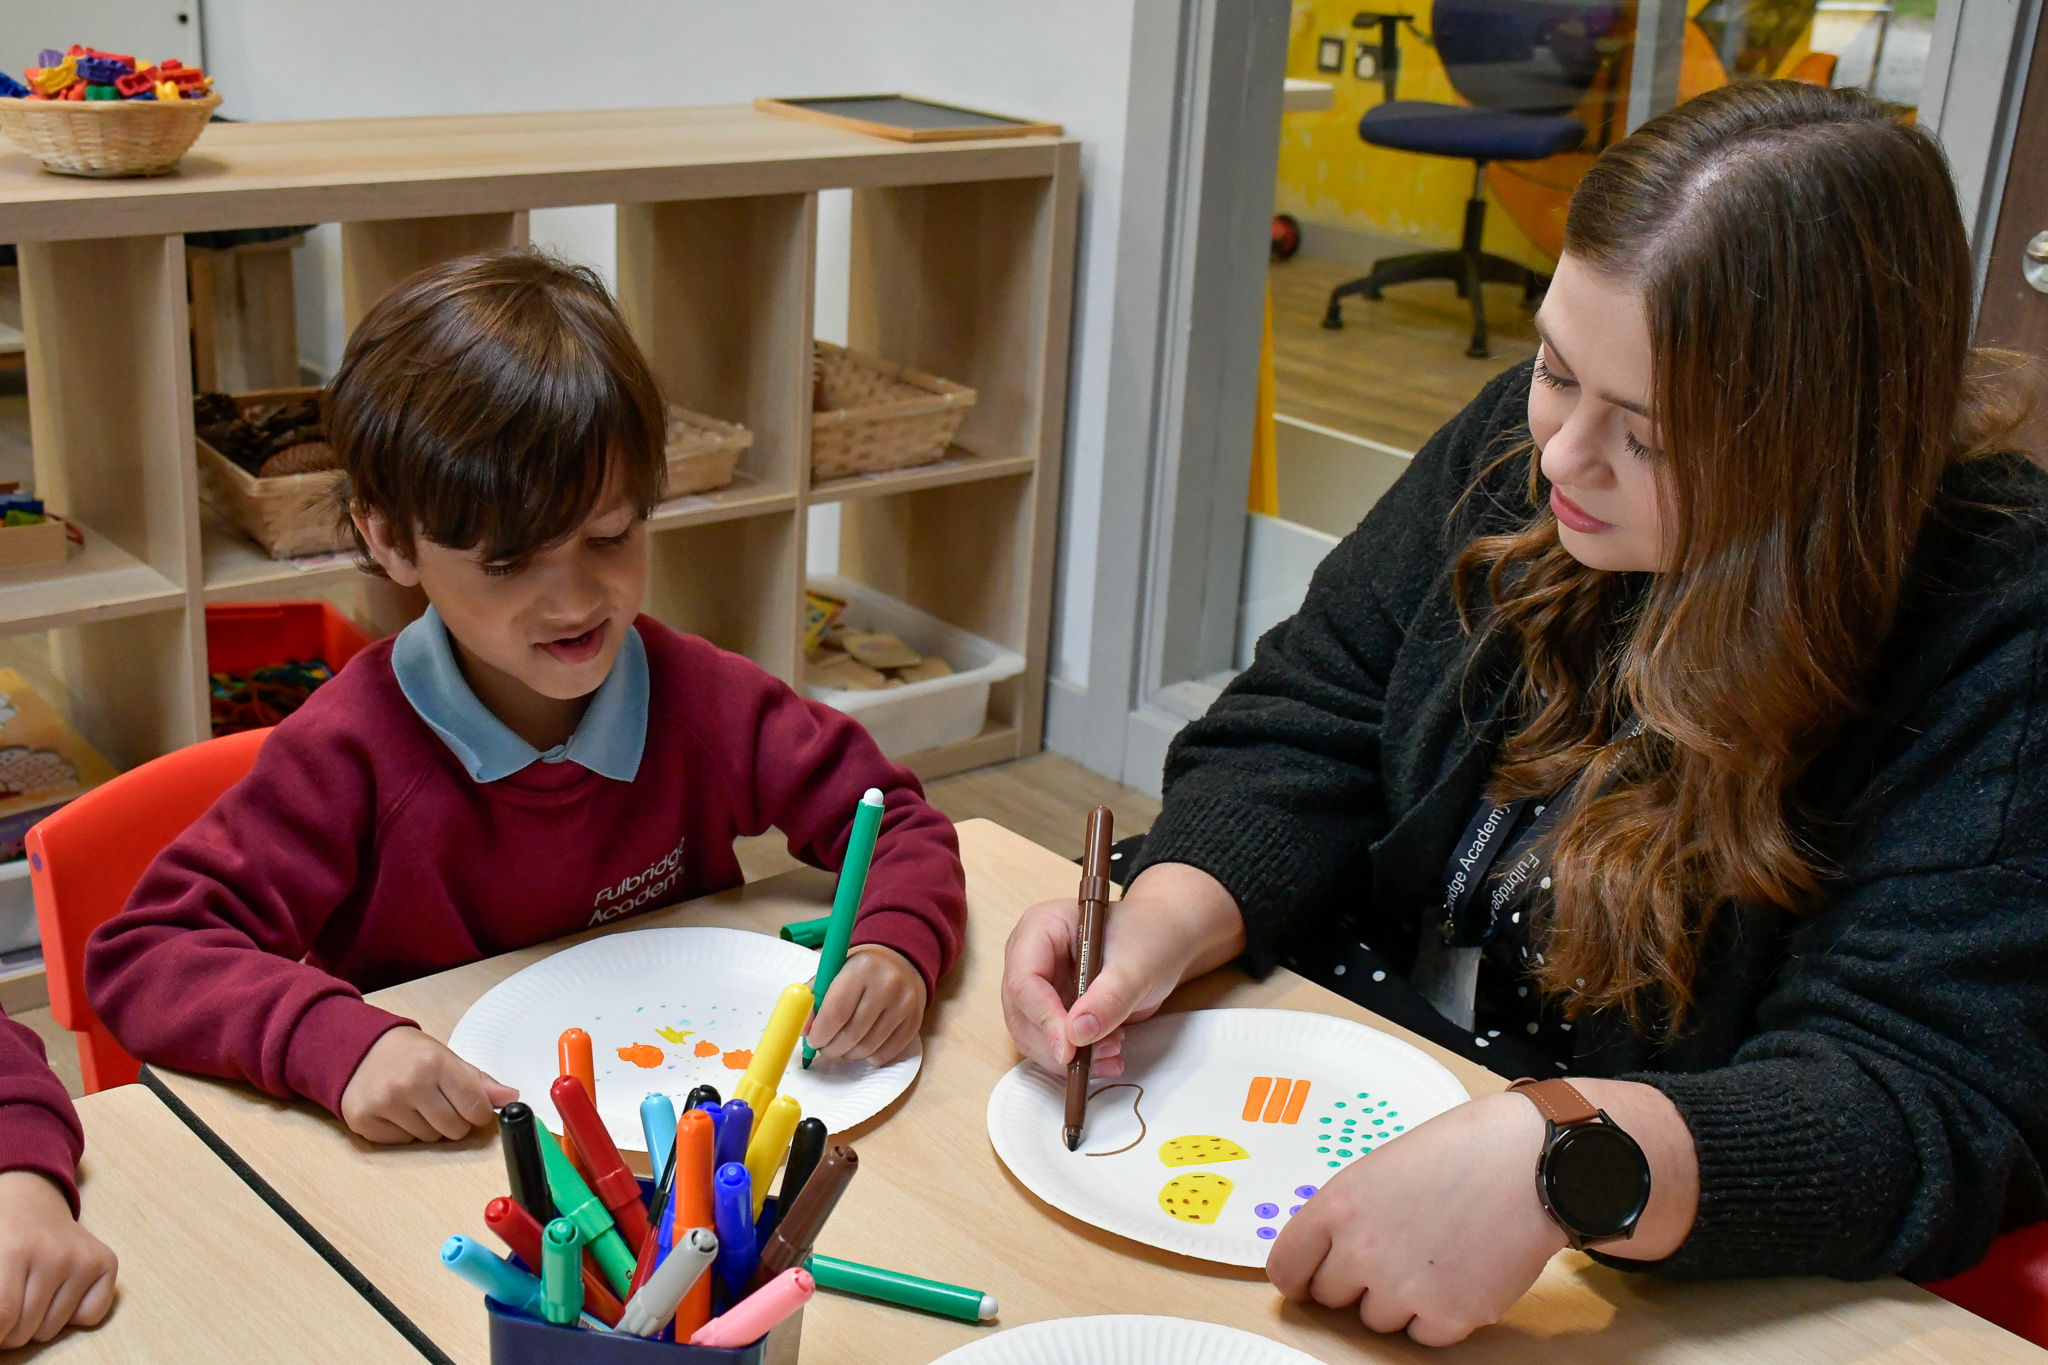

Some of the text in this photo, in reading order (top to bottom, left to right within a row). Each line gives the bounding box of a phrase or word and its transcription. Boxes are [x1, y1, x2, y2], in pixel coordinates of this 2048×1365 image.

[1459, 805, 1511, 872] Academ
[588, 866, 685, 927] Academ
[1490, 853, 1540, 910] Fulbridge
